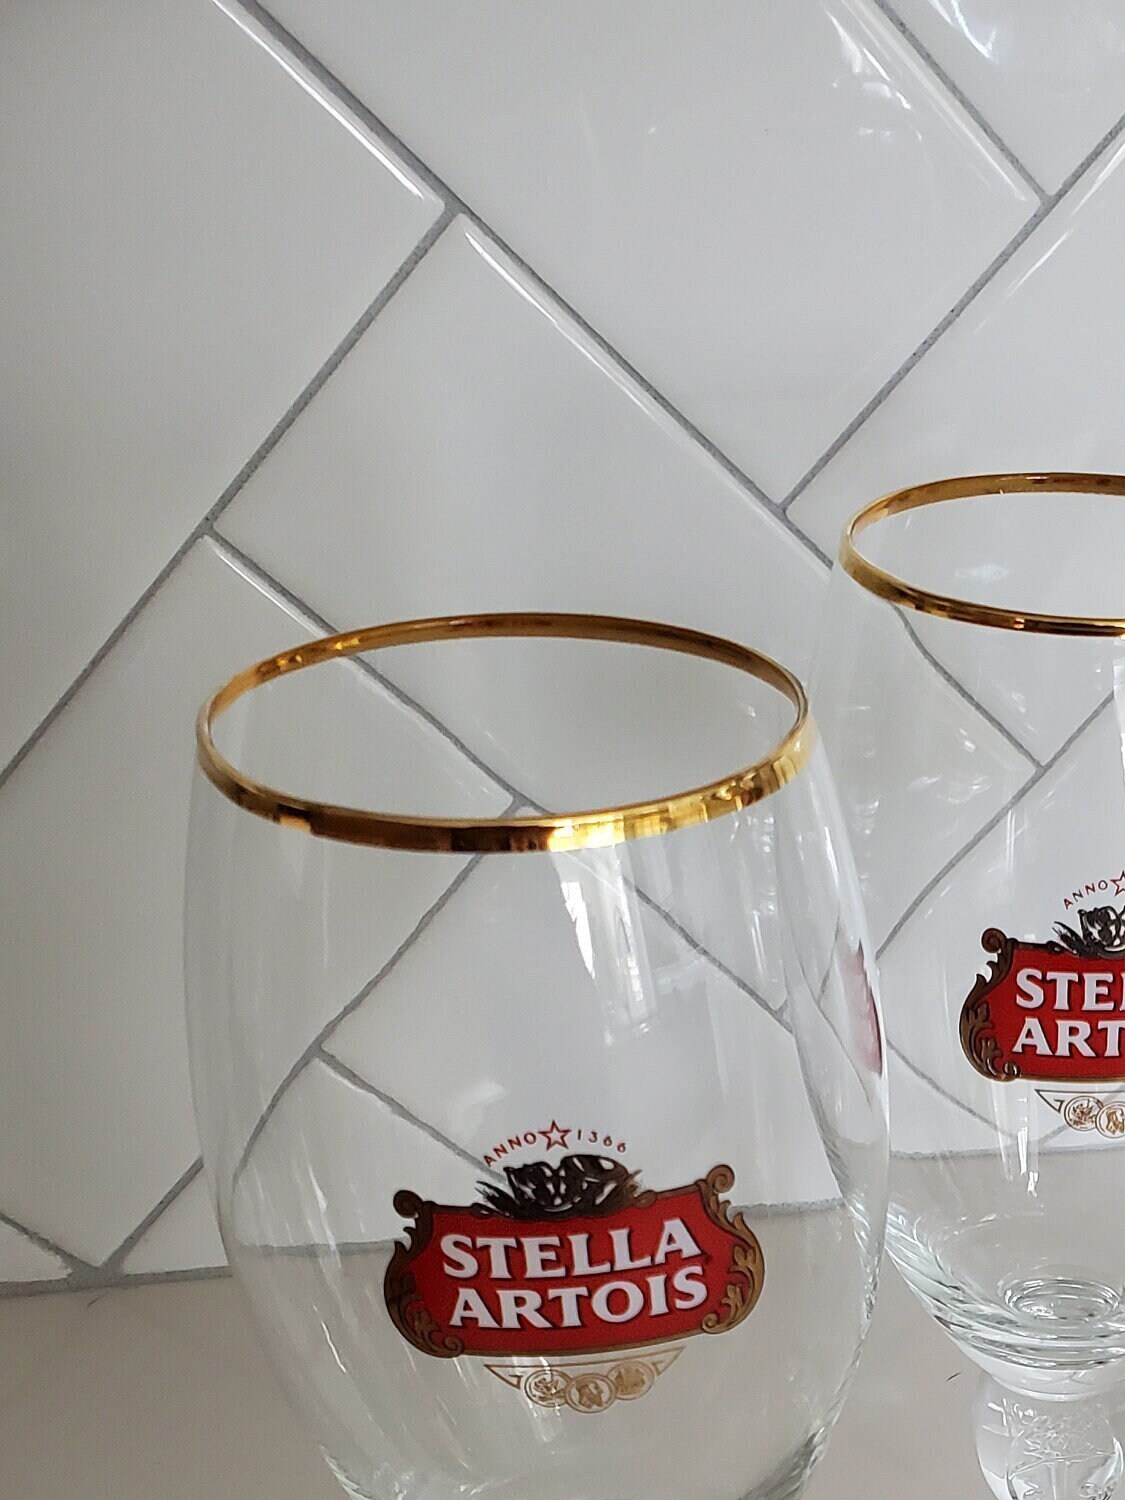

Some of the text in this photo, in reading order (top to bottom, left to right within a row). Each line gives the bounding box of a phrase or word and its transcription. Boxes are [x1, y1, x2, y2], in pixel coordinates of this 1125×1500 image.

[1063, 880, 1108, 910] ANNO
[484, 1130, 627, 1166] ANNO 1366
[440, 1218, 701, 1279] STELLA
[449, 1265, 708, 1328] ARTOIS
